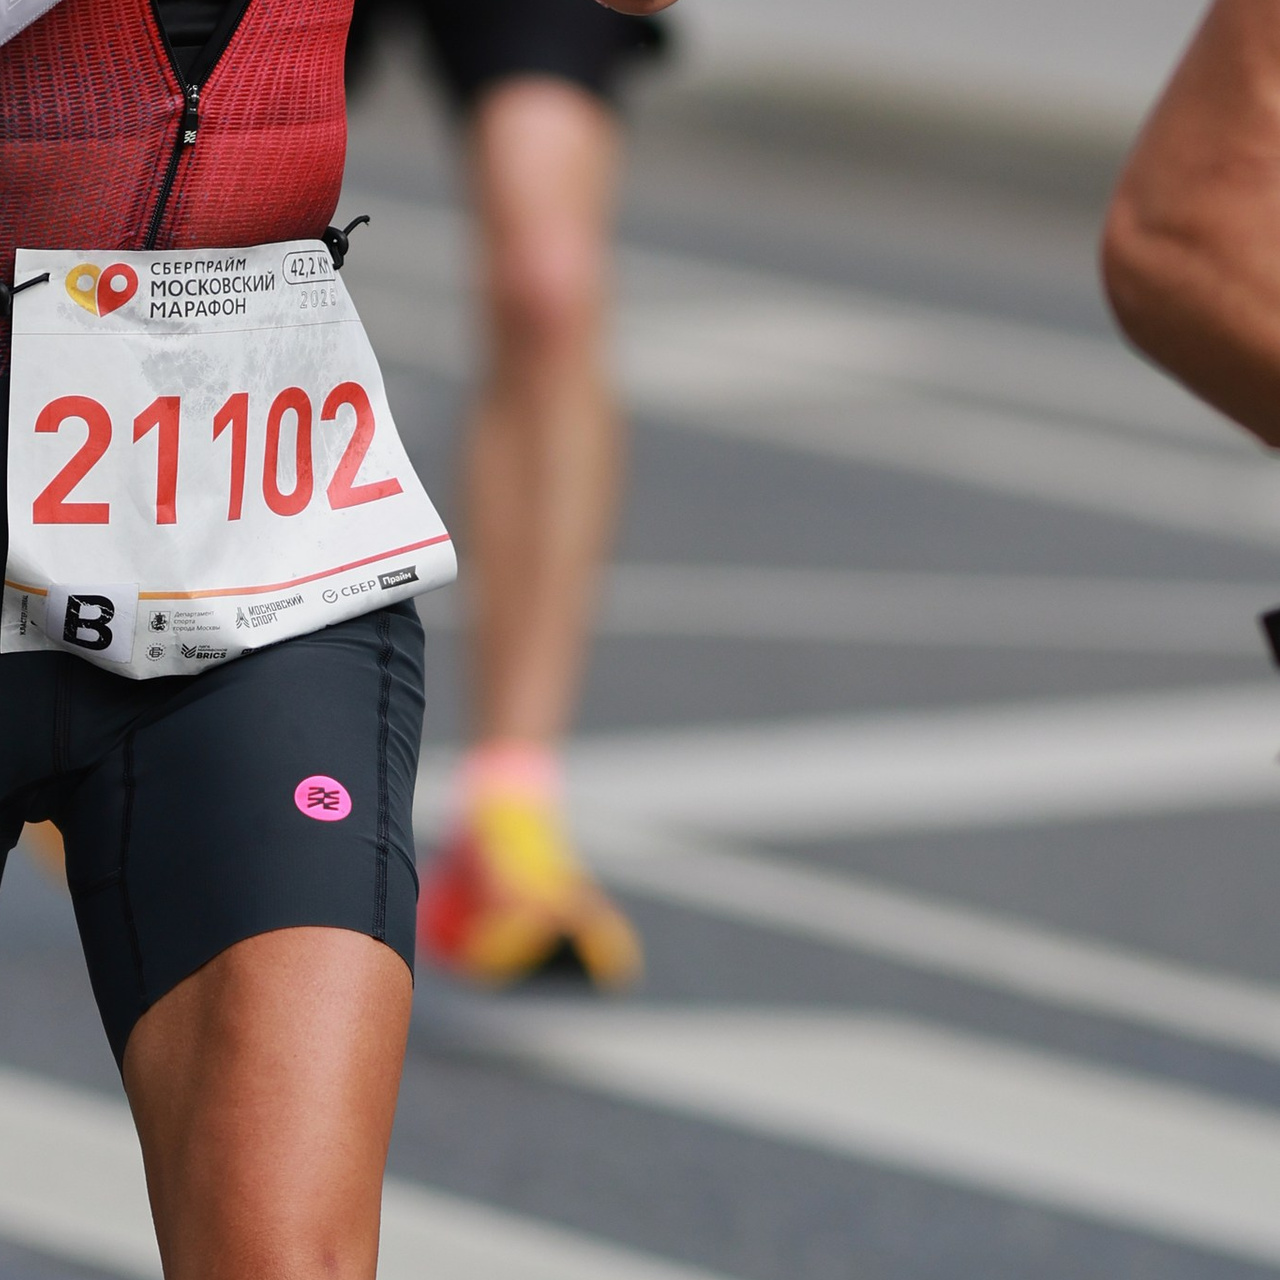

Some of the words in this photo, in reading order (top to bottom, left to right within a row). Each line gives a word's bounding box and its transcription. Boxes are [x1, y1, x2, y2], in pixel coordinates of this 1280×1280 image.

[150, 257, 247, 275] СБЕРПРАЙМ
[290, 257, 316, 279] 42,2
[150, 271, 275, 297] МОСКОВСКИЙ
[150, 297, 247, 319] МАРАФОН
[32, 381, 404, 525] 21102
[341, 580, 377, 597] СБЕР
[382, 571, 412, 586] Прайм
[248, 593, 304, 616] МОСКОВСКИЙ
[250, 612, 278, 628] СПОРТ
[196, 652, 227, 660] BRICS
